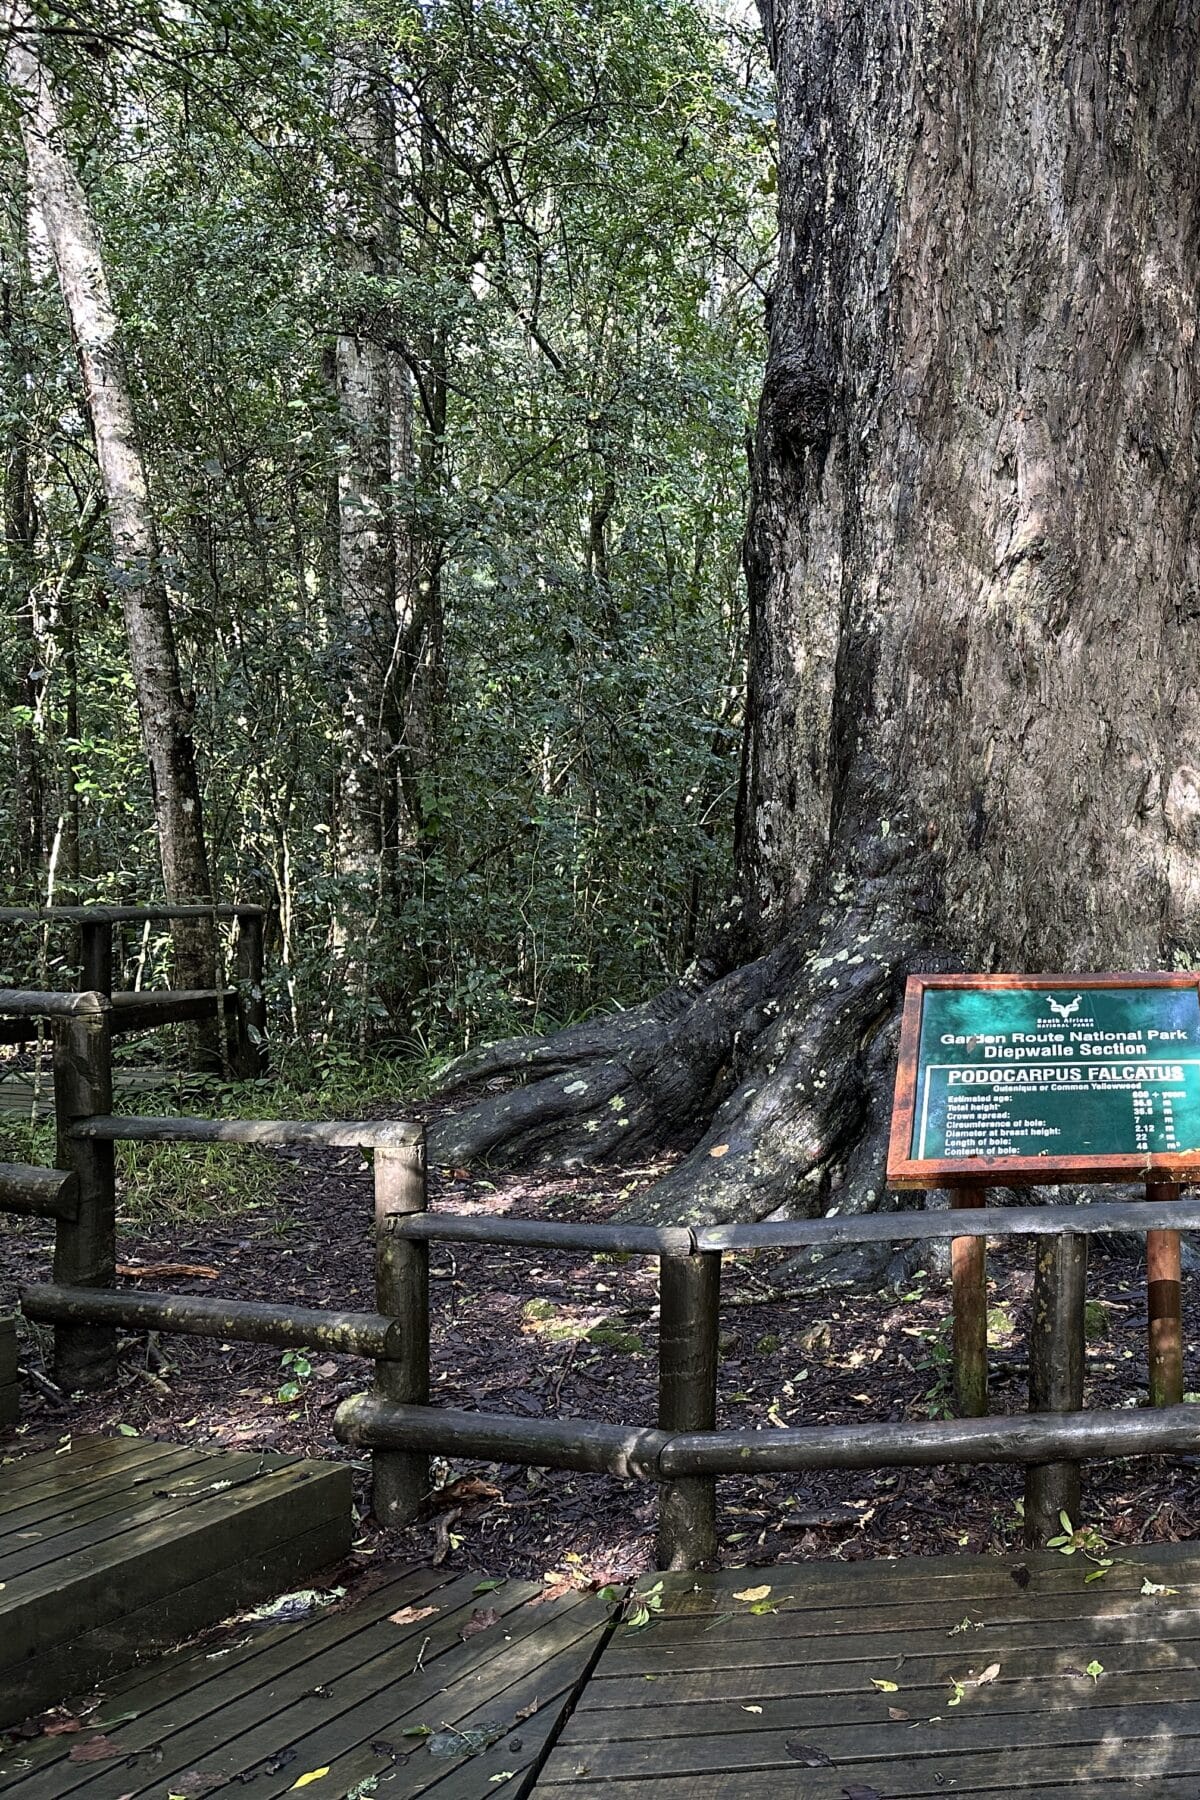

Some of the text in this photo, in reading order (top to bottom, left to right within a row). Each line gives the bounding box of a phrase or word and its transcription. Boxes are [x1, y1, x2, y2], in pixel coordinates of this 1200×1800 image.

[940, 1029, 1188, 1044] Garden Route National Park
[984, 1042, 1147, 1060] Diepwalle Section
[948, 1066, 1184, 1083] PODOCARPUS FALCATUS
[993, 1085, 1037, 1093] Outeniqua
[1051, 1083, 1089, 1091] Common
[1091, 1082, 1142, 1090] Yellowwood
[993, 1095, 1013, 1103] age:
[947, 1112, 975, 1120] Crown
[977, 1111, 1010, 1120] spread:
[946, 1120, 1011, 1129] Circumference
[1024, 1119, 1046, 1127] bole:
[1134, 1116, 1140, 1124] 7
[945, 1129, 987, 1138] Diameter
[1000, 1128, 1029, 1136] breast
[1030, 1128, 1061, 1137] height:
[945, 1139, 976, 1148] Length
[978, 1138, 987, 1146] of
[989, 1138, 1012, 1146] bole:
[944, 1147, 984, 1156] Contents
[998, 1146, 1020, 1154] bole:
